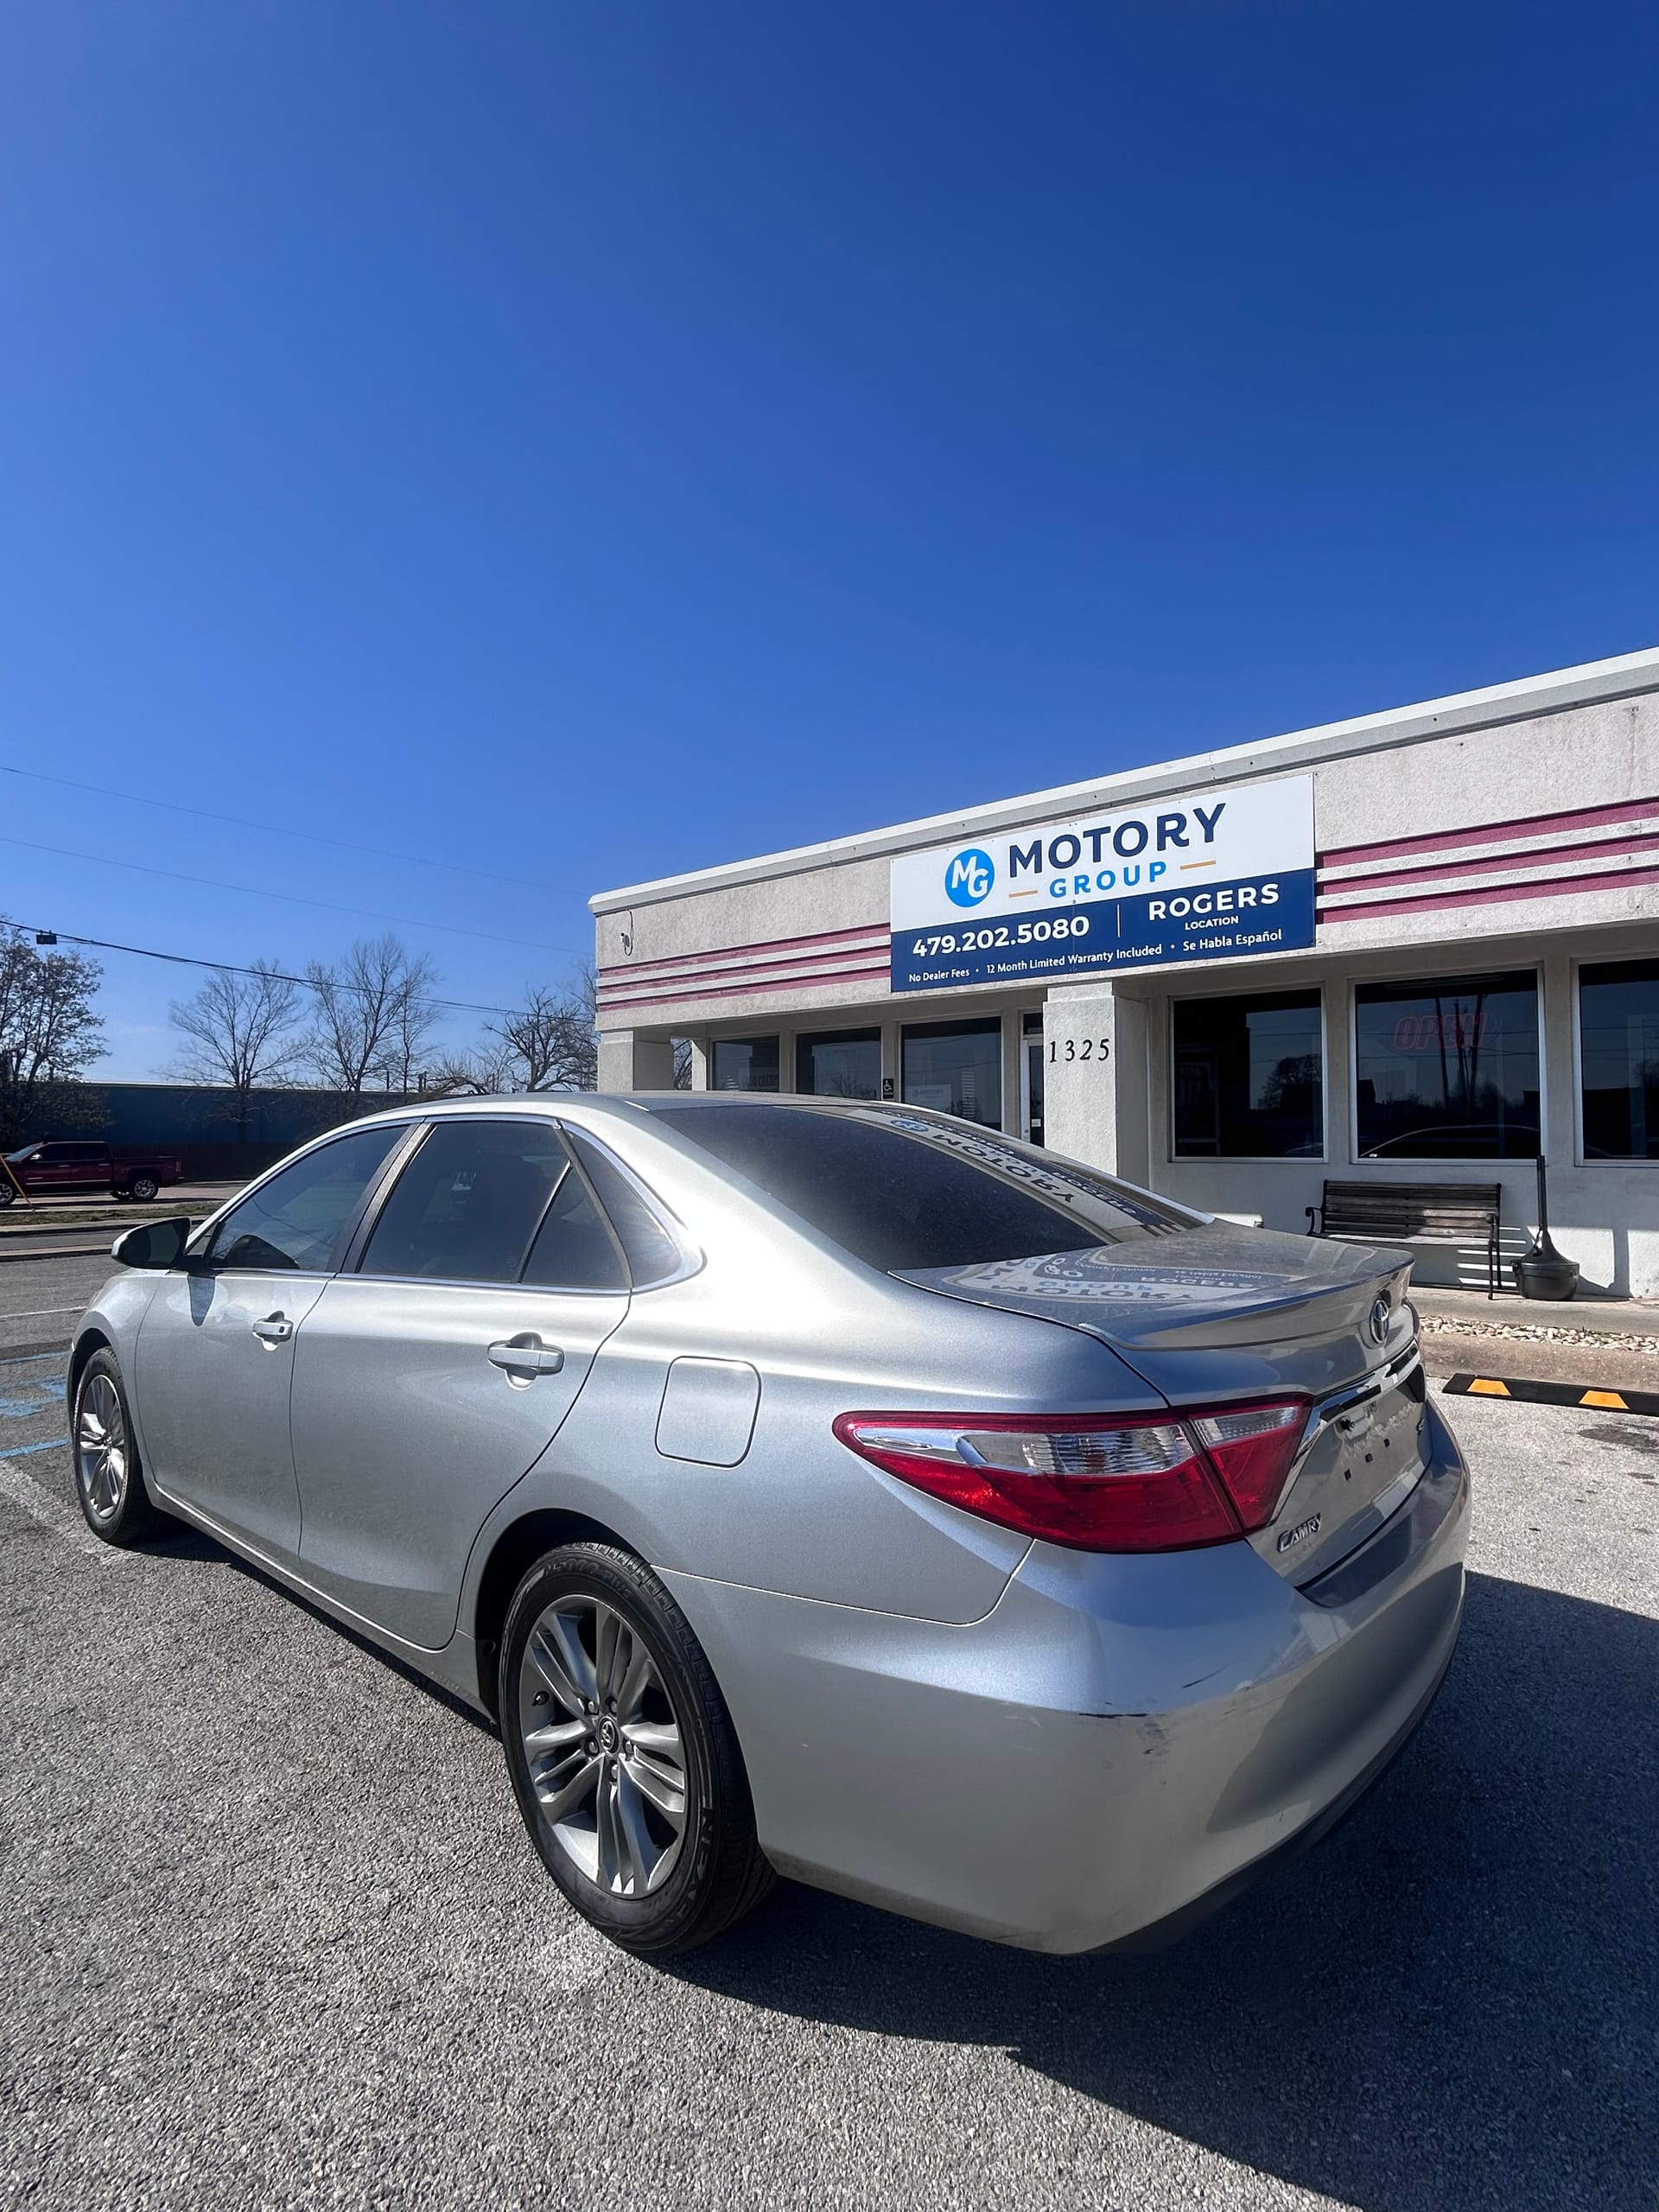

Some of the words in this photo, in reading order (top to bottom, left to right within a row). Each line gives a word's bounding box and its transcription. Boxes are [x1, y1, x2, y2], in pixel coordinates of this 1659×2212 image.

[1009, 802, 1227, 878] MOTORY
[950, 856, 989, 898] MG
[1049, 861, 1166, 899] GROUP
[1148, 882, 1280, 922] ROGERS
[912, 915, 1090, 957] 479.202.5080
[1185, 915, 1239, 931] LOCATION
[908, 973, 921, 982] No
[923, 970, 950, 982] Dealer
[950, 969, 969, 978] Fees
[986, 964, 995, 974] 12
[997, 960, 1027, 973] Month
[1029, 956, 1065, 969] Limited
[1067, 951, 1113, 964] Warranty
[1116, 944, 1162, 959] Included
[1183, 941, 1197, 951] Se
[1199, 936, 1232, 950] Habla
[1236, 929, 1282, 947] Español
[1049, 1038, 1110, 1064] 1325
[1394, 1012, 1488, 1051] OPEN
[1277, 1512, 1324, 1554] CAMRY
